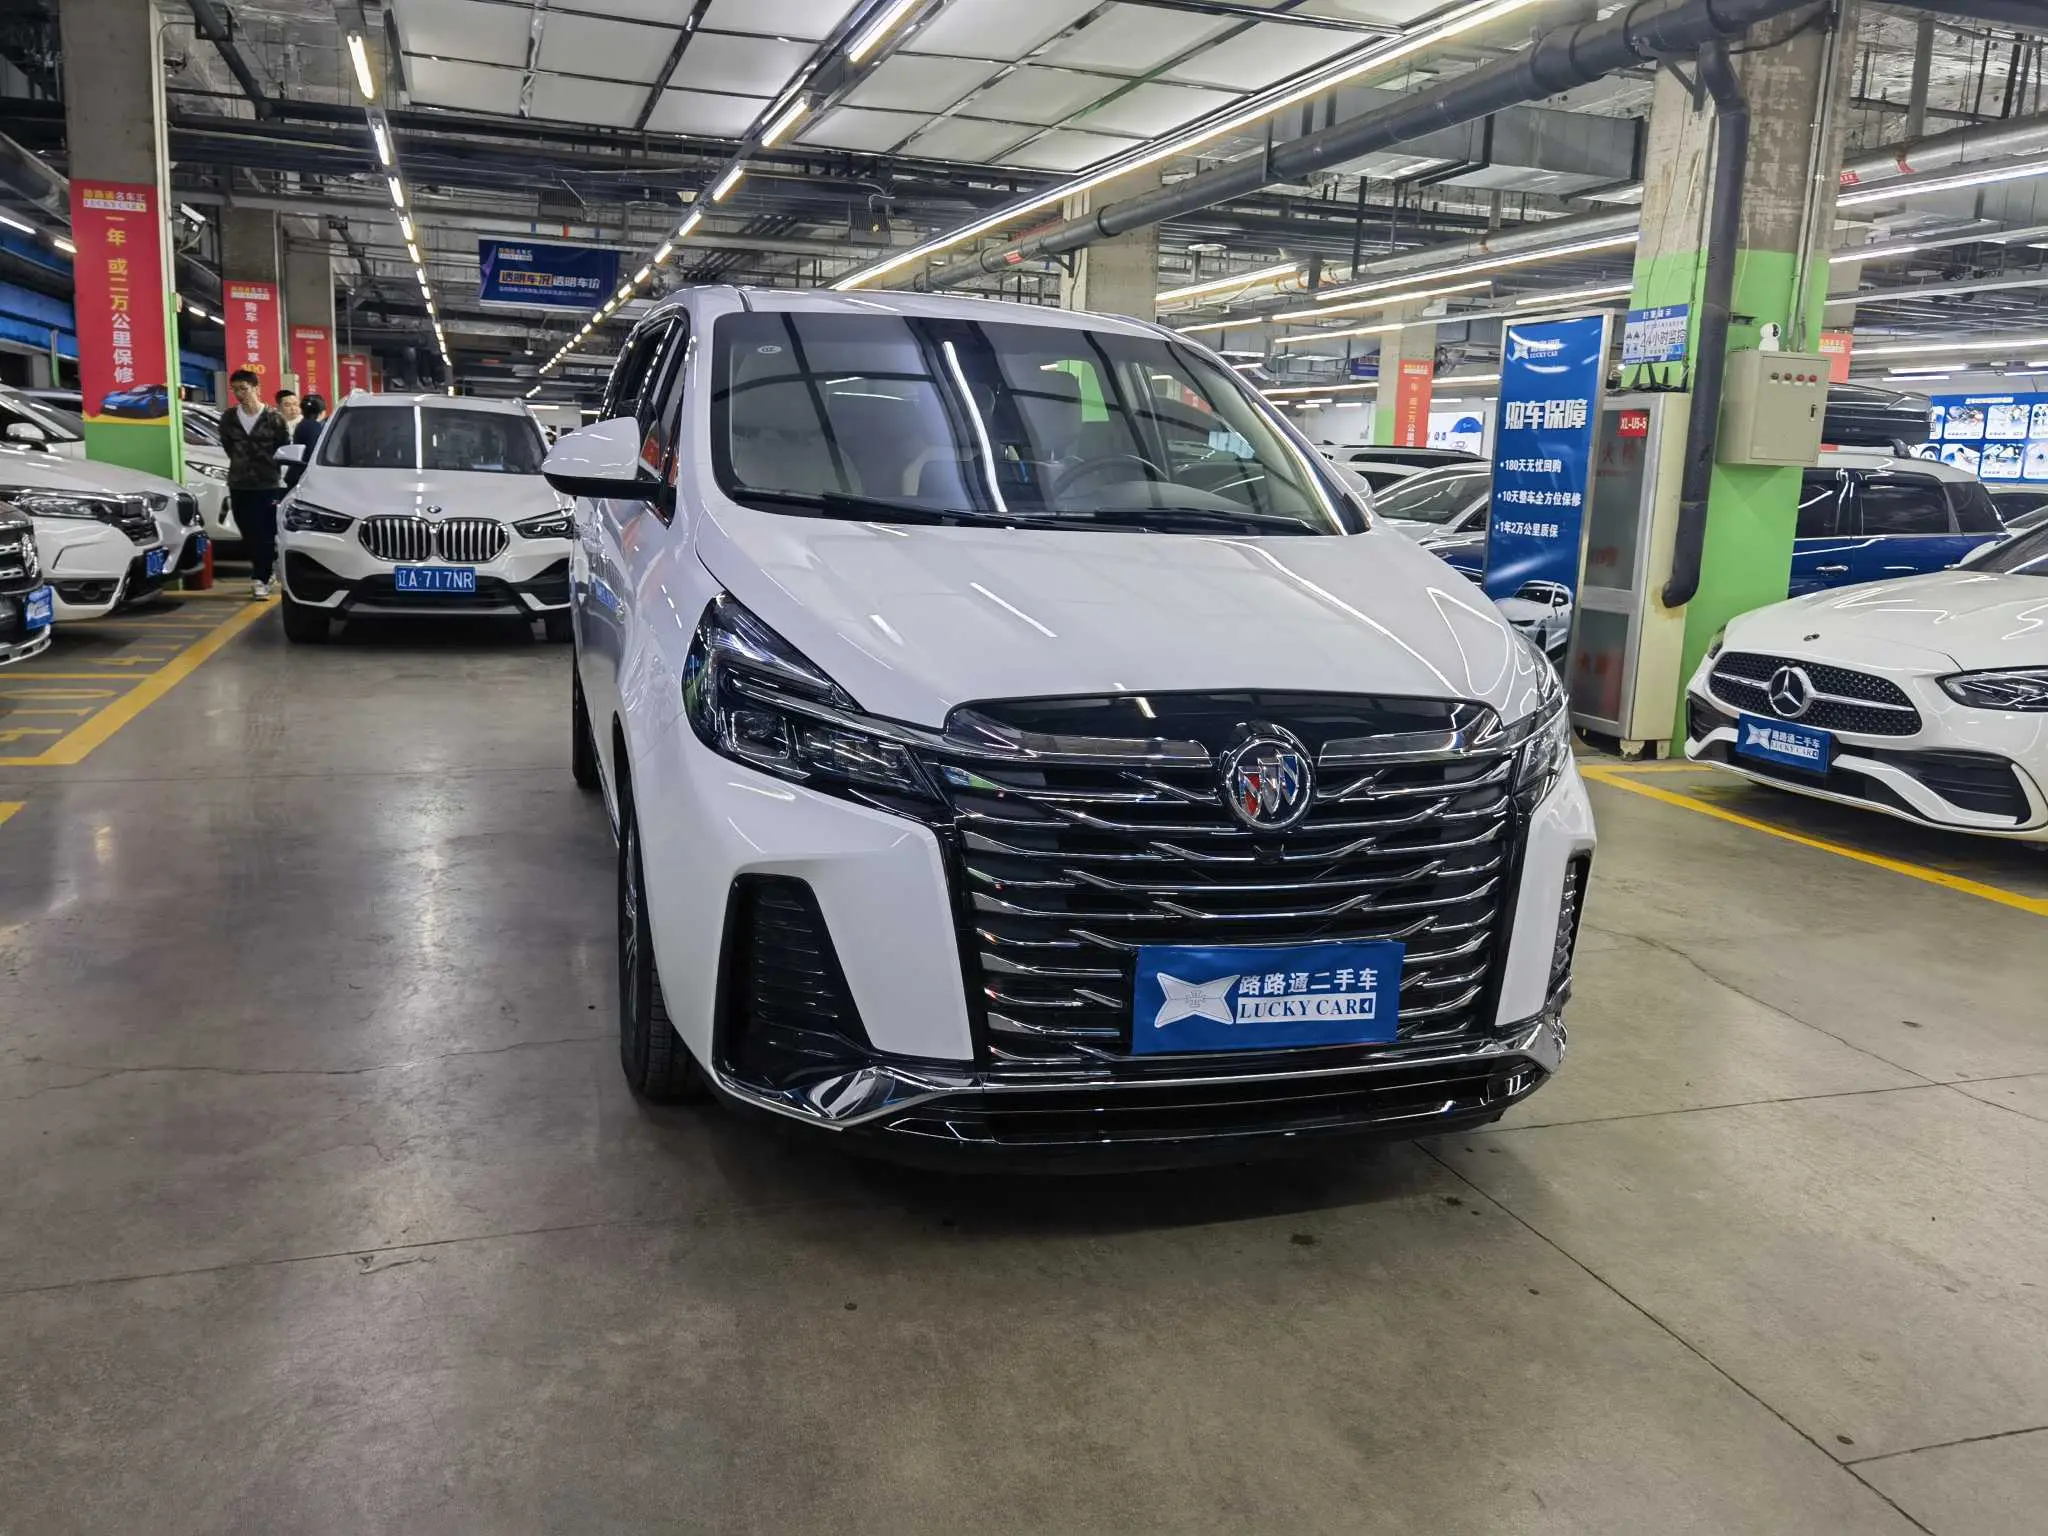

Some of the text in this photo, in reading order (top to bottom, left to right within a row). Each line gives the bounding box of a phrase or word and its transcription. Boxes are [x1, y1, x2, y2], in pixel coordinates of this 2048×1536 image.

[1505, 398, 1588, 430] 购车保障
[1505, 458, 1562, 473] 180天无忧回购
[1502, 489, 1582, 507] 10天整车全方位保修
[1500, 520, 1559, 538] 1年2万公里质保
[1238, 967, 1379, 996] 路路通二手车
[1240, 998, 1358, 1019] LUCKY CAR
